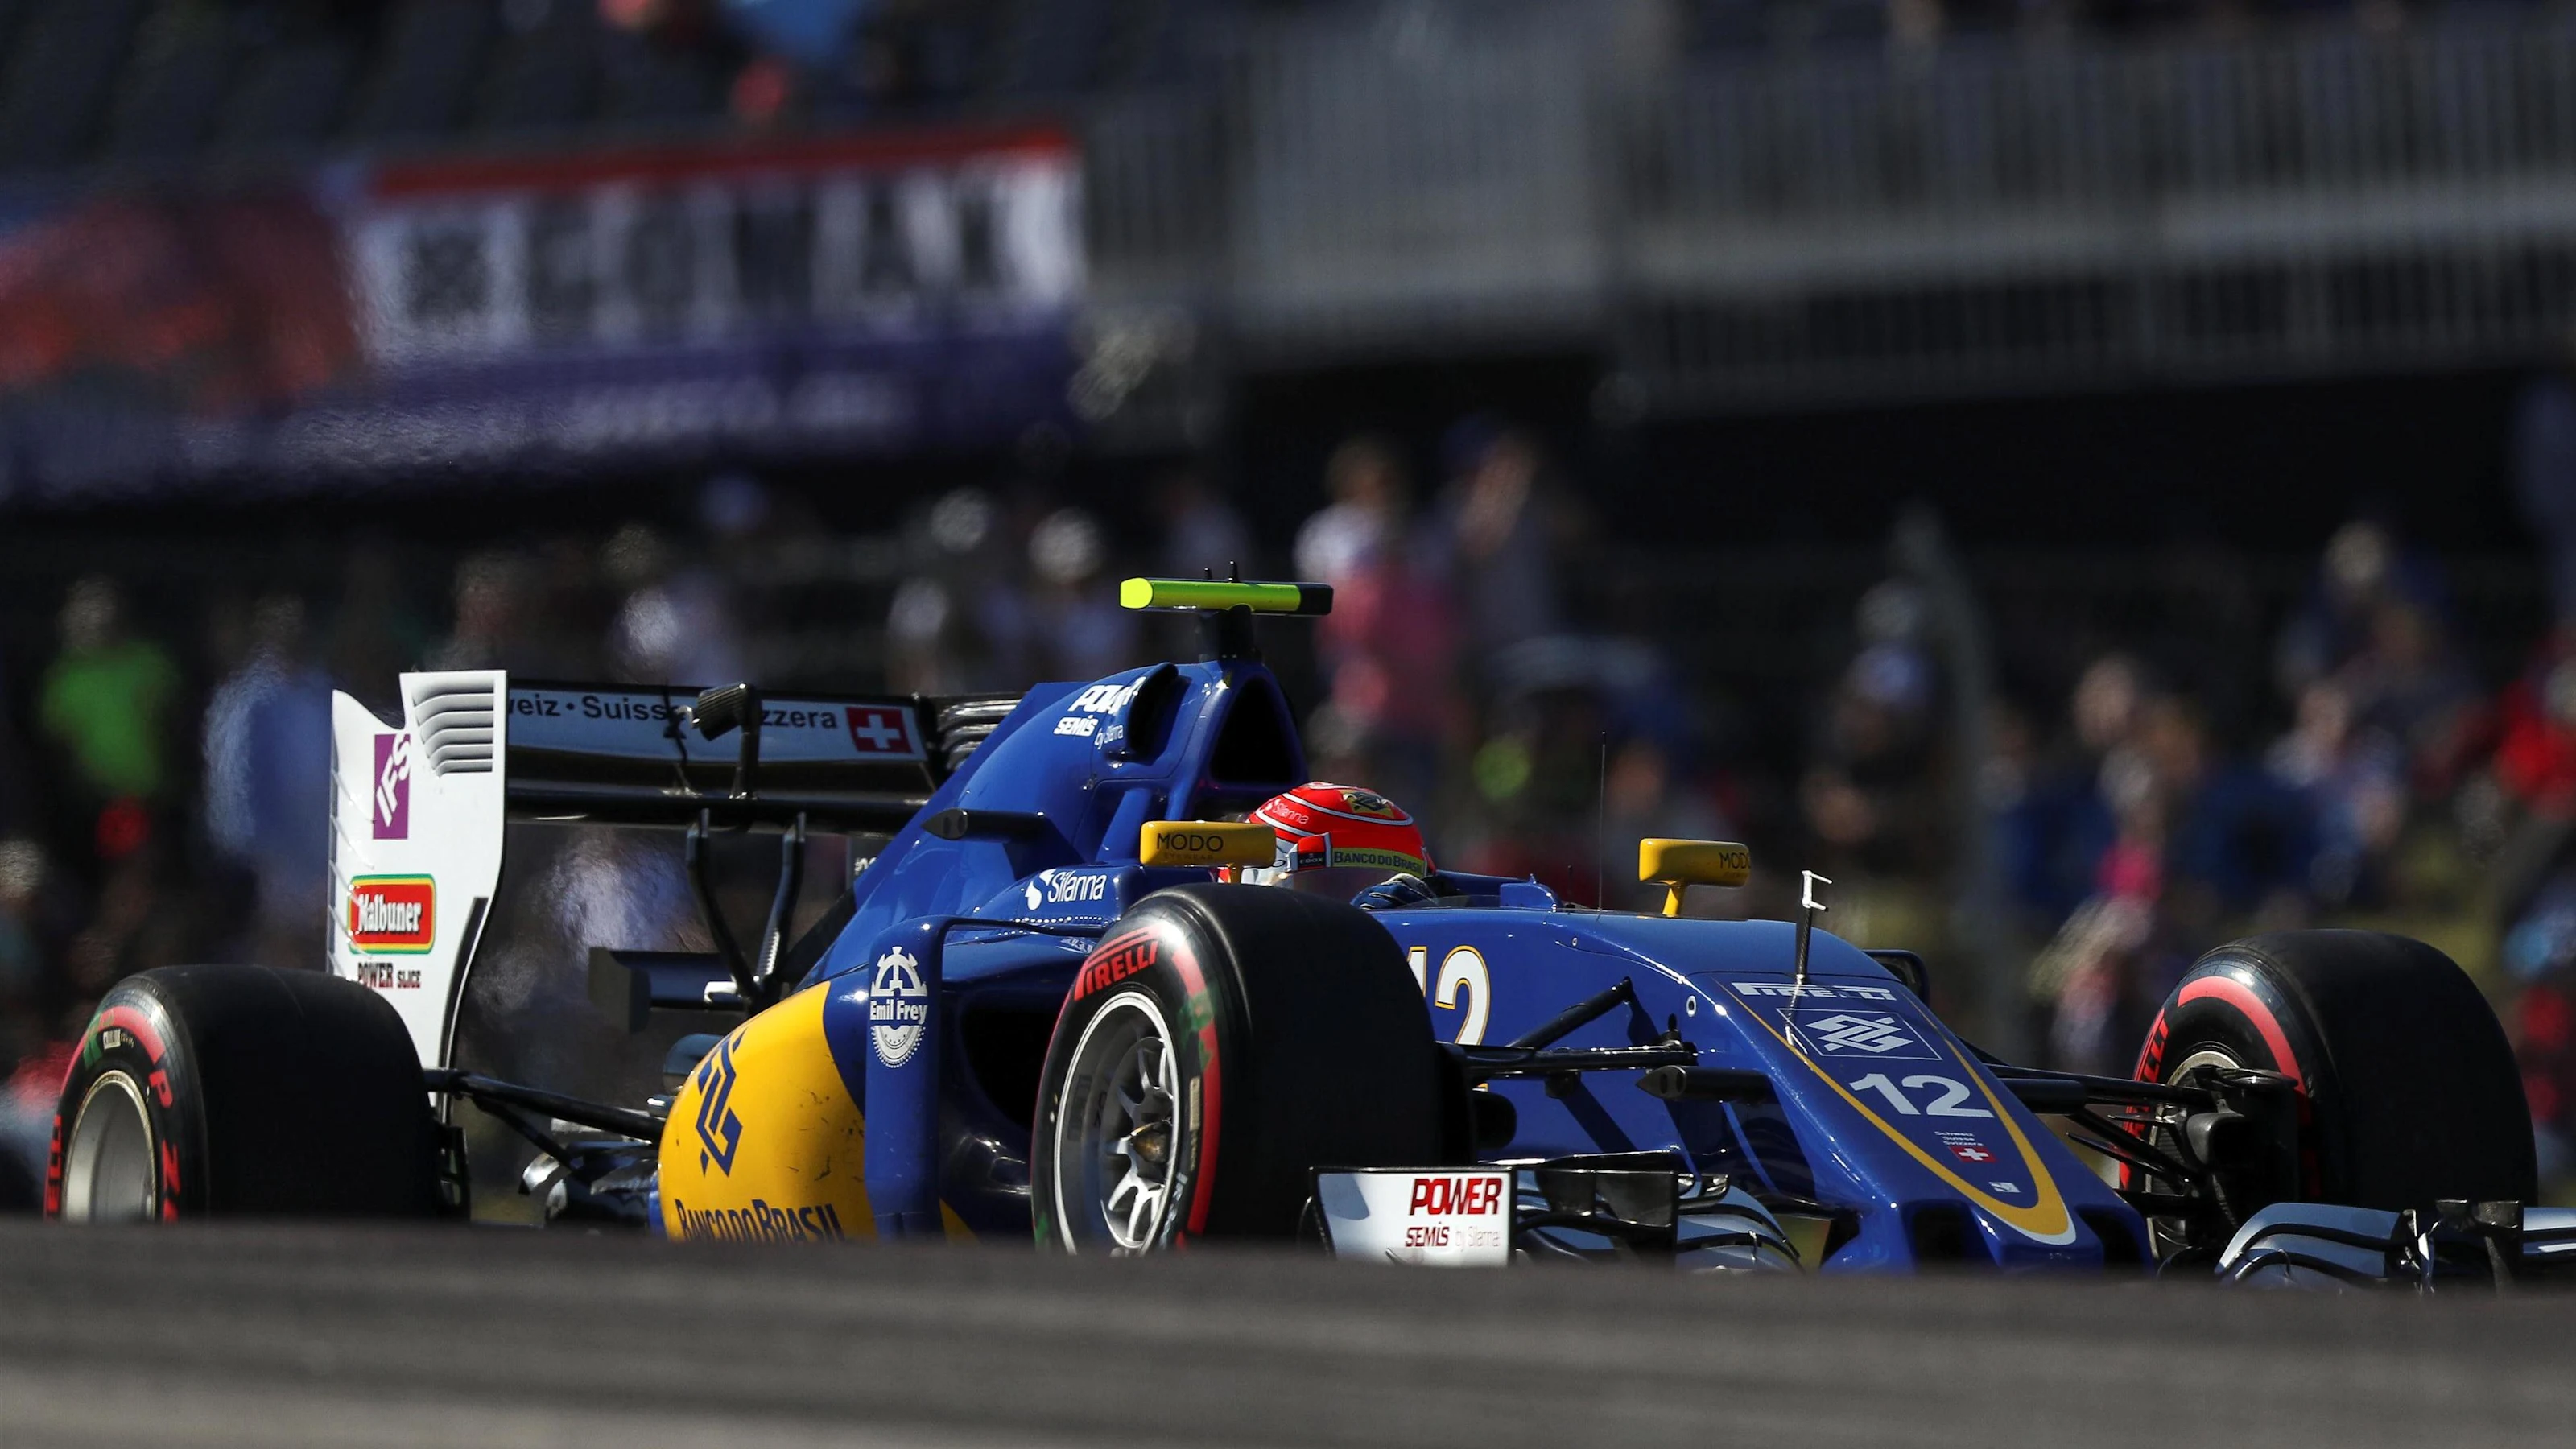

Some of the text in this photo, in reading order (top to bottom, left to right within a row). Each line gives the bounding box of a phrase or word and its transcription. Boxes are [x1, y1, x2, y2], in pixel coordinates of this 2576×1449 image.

[376, 733, 411, 828] IFS
[1157, 832, 1224, 852] MODO
[1334, 851, 1375, 865] BANCO
[1048, 870, 1107, 902] Silanna
[358, 962, 394, 988] POWER
[1073, 923, 1160, 1001] PIRELLI
[869, 999, 928, 1025] Emil Frey
[1849, 1073, 1995, 1118] 12
[1408, 1178, 1503, 1216] POWER
